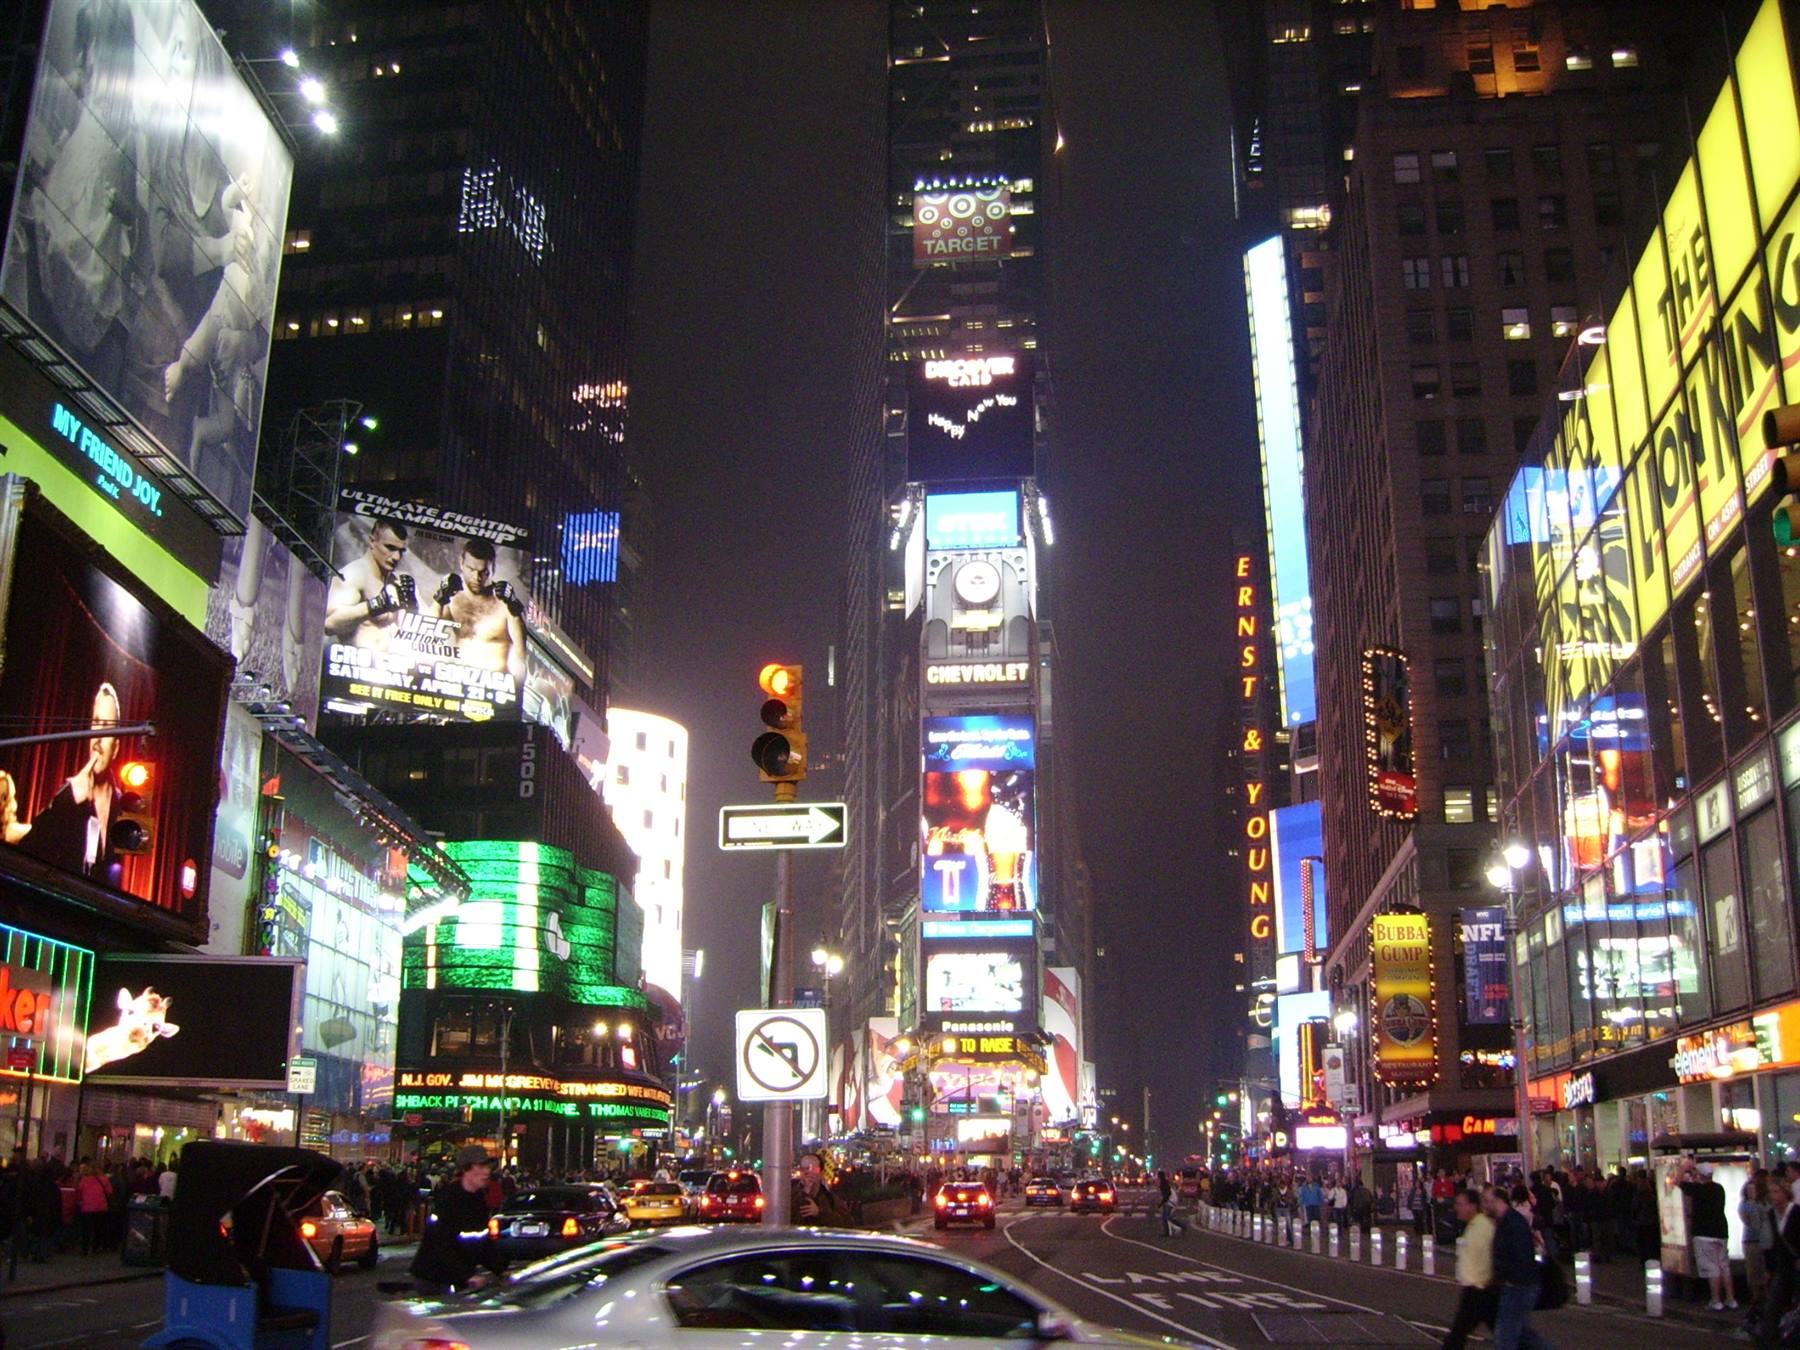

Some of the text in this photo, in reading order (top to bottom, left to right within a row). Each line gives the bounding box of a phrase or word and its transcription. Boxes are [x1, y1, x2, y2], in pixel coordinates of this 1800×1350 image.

[923, 236, 1002, 256] TARGET
[1658, 221, 1709, 354] THE
[948, 373, 992, 387] CARD
[928, 413, 966, 439] Happy
[995, 394, 1017, 406] You
[1630, 231, 1800, 583] LION KING
[53, 403, 162, 517] MY FRIEND JOY.
[340, 488, 438, 518] ULTIMATE
[442, 511, 529, 538] FIGHTING
[355, 502, 516, 544] CHAMPIONSHIP
[1672, 454, 1769, 587] ENTRANCE ON 45TH STREET
[400, 612, 453, 639] UFC
[394, 629, 448, 646] NATIONS
[410, 641, 462, 659] COLLIDE
[329, 643, 372, 670] CRO
[434, 661, 516, 695] GONZAGA
[927, 663, 1029, 684] CHEVROLET
[349, 683, 460, 711] SEE IT FREE ONLY ON
[421, 677, 464, 698] APRIL
[467, 686, 486, 701] 21
[1237, 556, 1271, 939] ERNST & YOUNG
[520, 724, 536, 799] 1500
[1377, 923, 1426, 942] BUBBA
[1461, 924, 1505, 942] NFL
[1381, 945, 1424, 962] GUMP
[1465, 943, 1480, 1000] DRAFT
[942, 1021, 1014, 1032] Panasonic
[961, 1037, 1013, 1053] TO RAISE
[401, 1074, 424, 1086] N.J.
[427, 1074, 454, 1087] GOV.
[588, 1103, 634, 1117] THOMAS
[1081, 1271, 1243, 1283] LANE
[1132, 1292, 1327, 1309] FIRE
